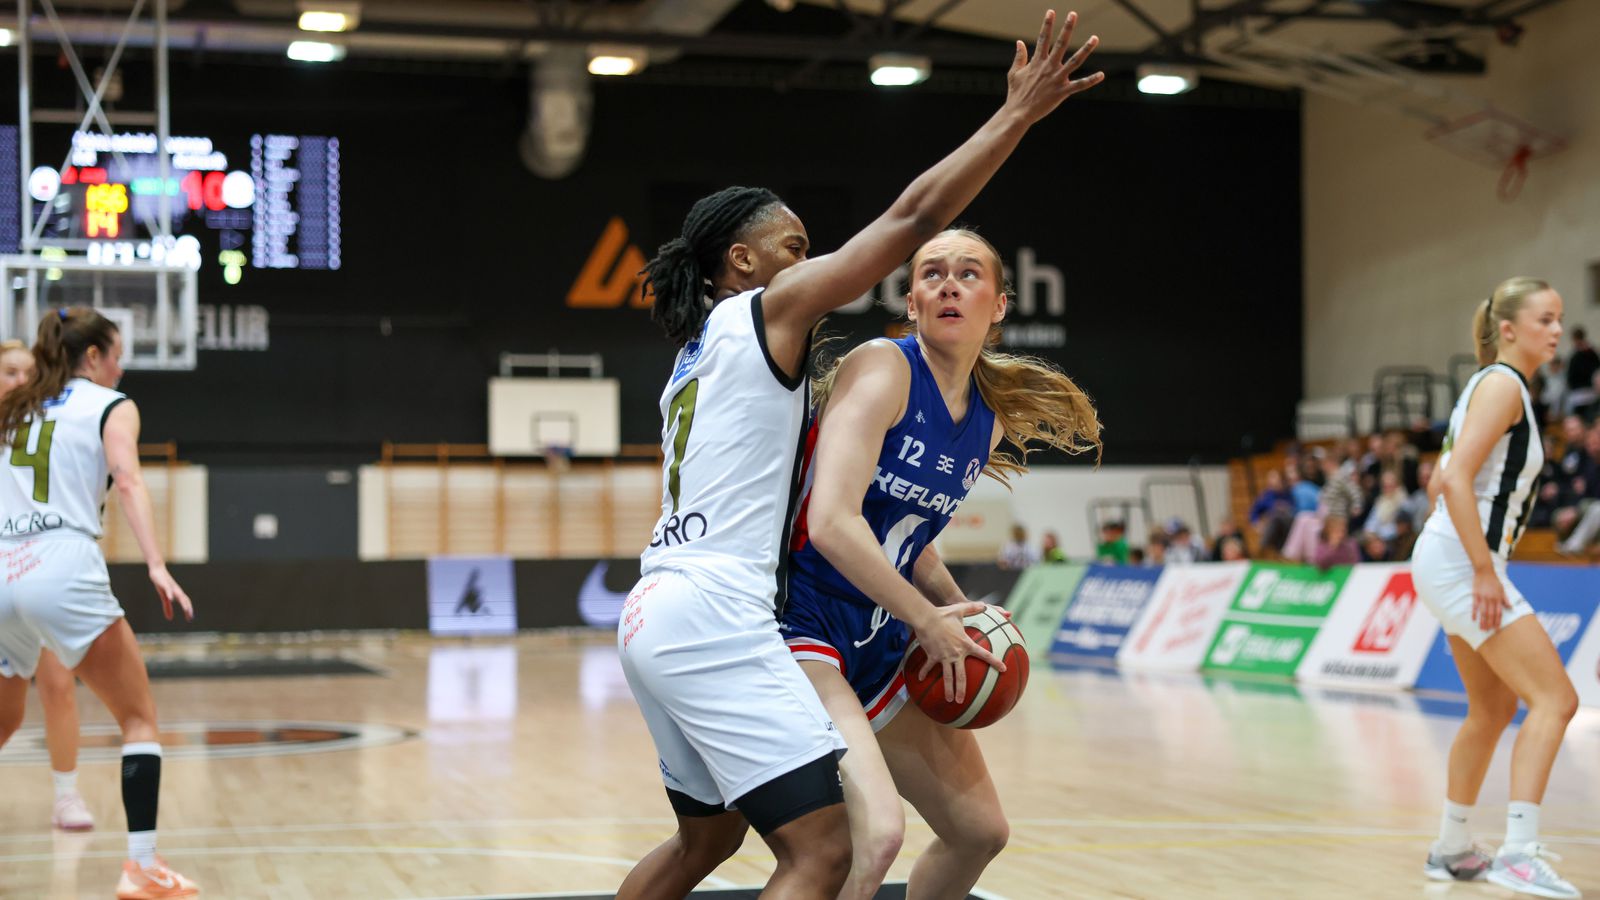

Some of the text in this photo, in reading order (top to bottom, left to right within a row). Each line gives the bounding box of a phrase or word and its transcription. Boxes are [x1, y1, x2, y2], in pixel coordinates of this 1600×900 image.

[10, 419, 56, 503] 4
[898, 434, 926, 468] 12
[871, 465, 965, 518] KEFLAVÍ
[0, 511, 63, 538] ACRO
